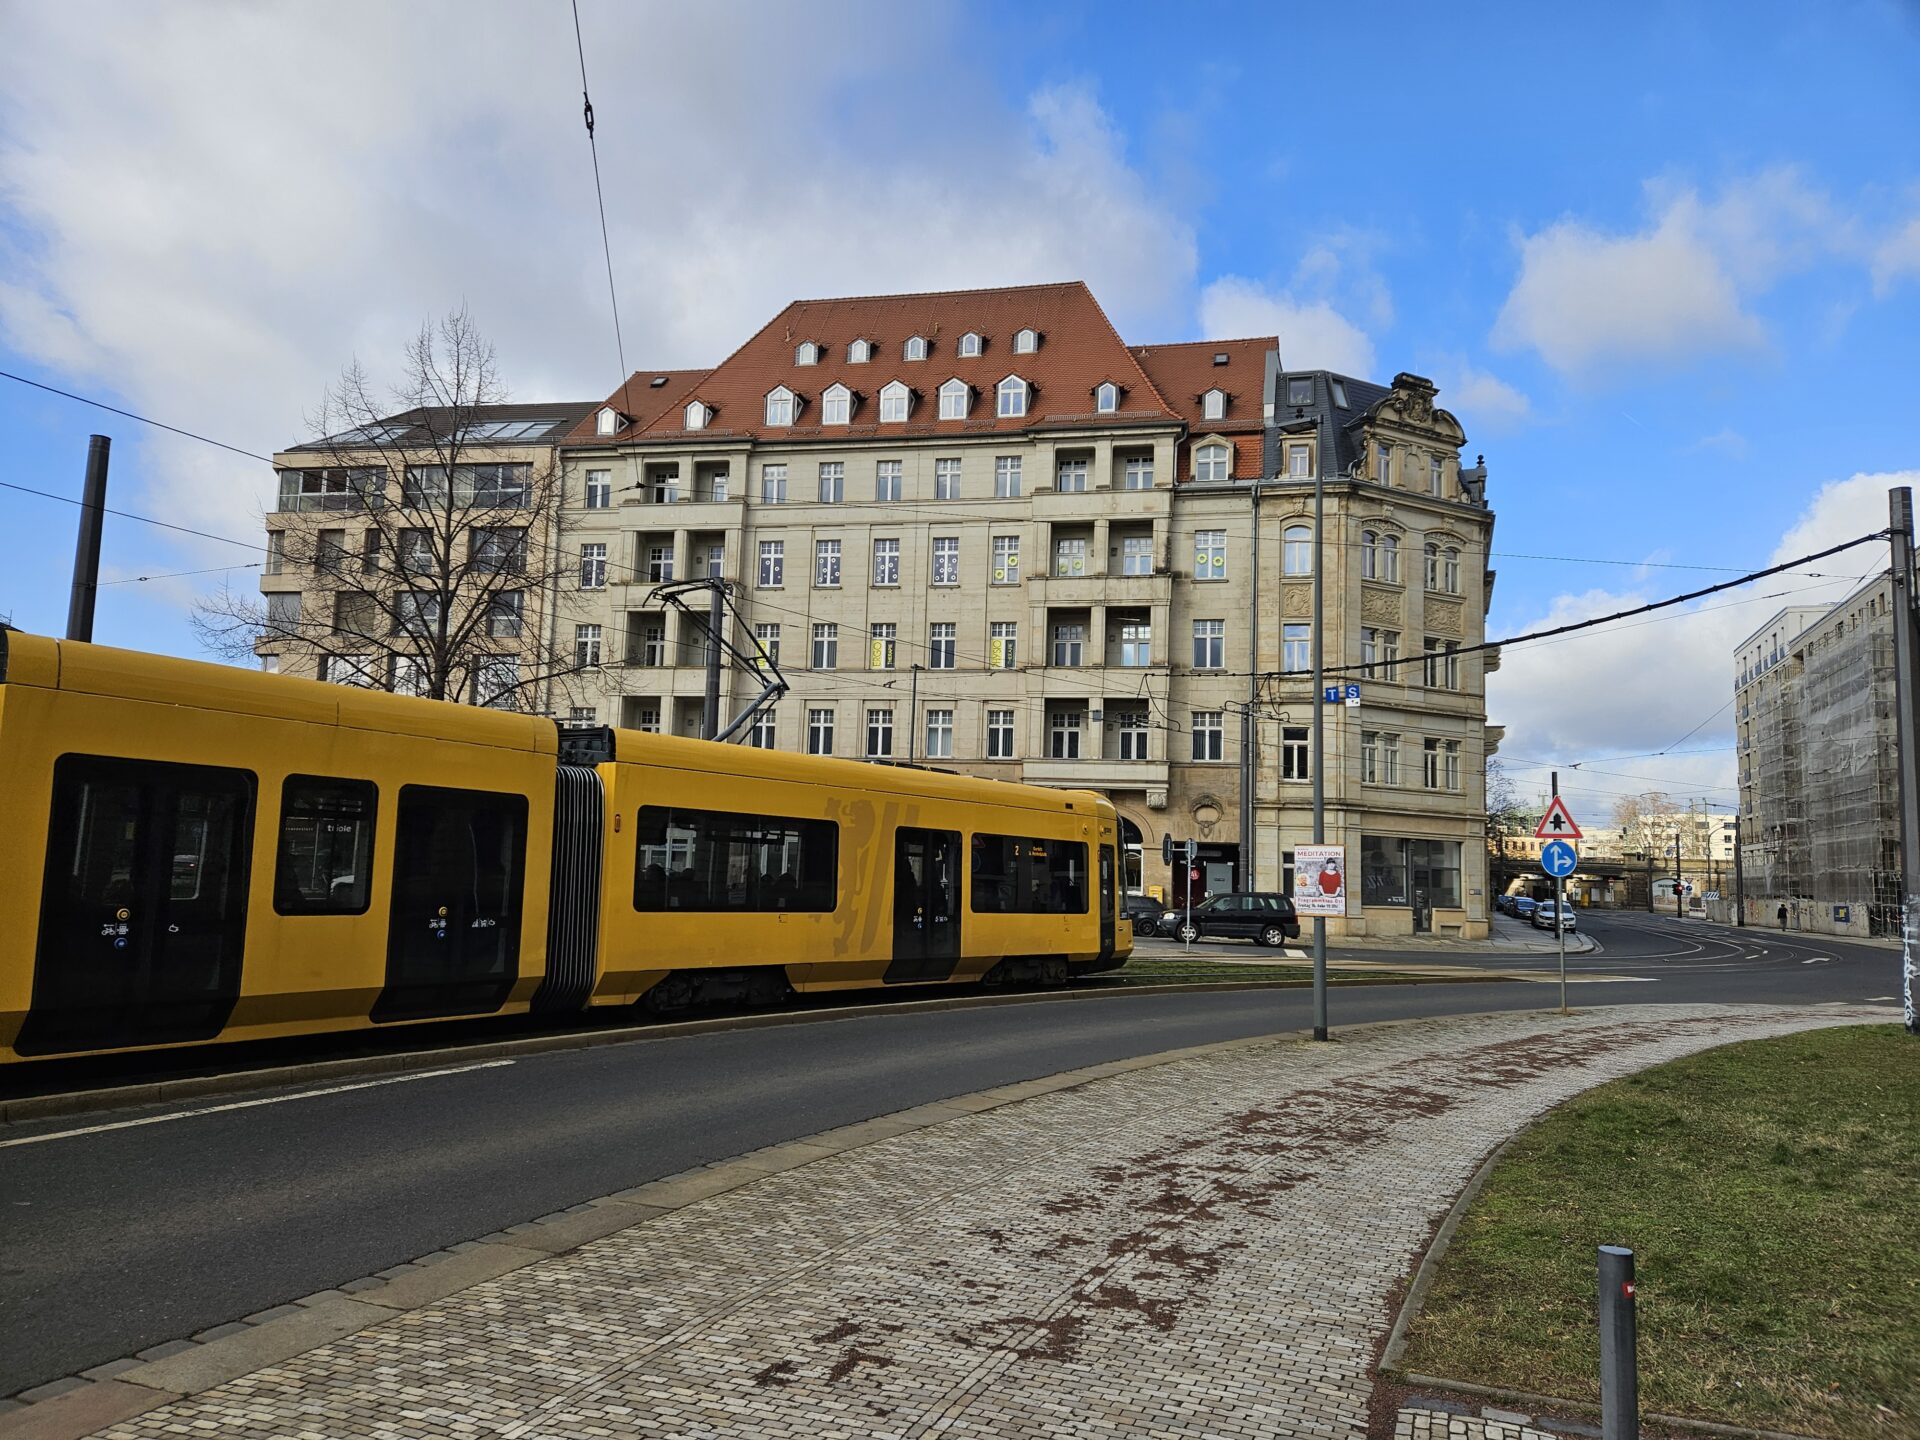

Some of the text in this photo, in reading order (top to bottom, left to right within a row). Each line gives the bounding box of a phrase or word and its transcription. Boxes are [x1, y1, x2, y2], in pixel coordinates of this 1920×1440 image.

[872, 642, 882, 666] ERGO
[1328, 689, 1336, 700] T
[1348, 687, 1357, 698] S
[1014, 846, 1020, 856] 2
